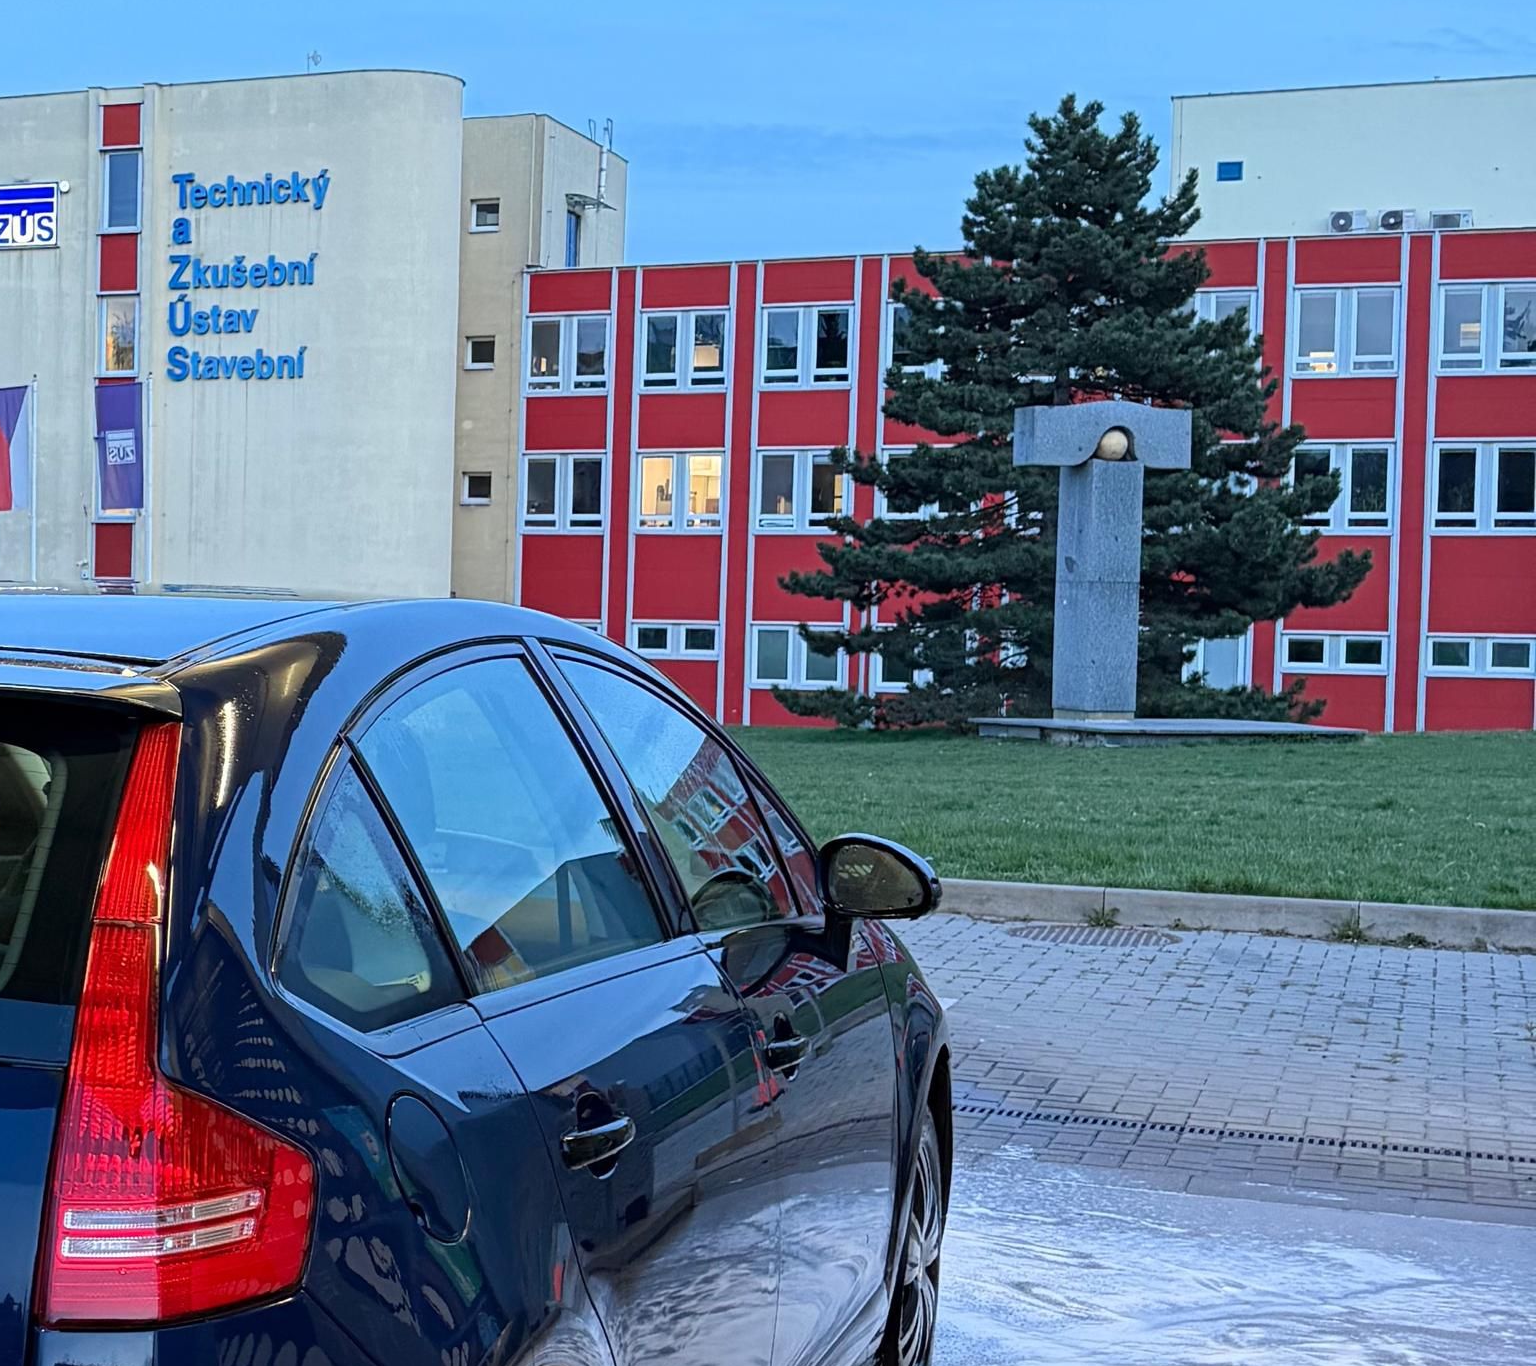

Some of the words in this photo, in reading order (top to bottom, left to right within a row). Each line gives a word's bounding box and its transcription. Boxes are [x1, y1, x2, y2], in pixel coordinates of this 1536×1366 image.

[172, 169, 330, 210] Technický
[172, 217, 192, 245] a
[168, 252, 318, 290] Zkušební
[168, 294, 258, 336] Ústav
[166, 346, 307, 382] Stavební
